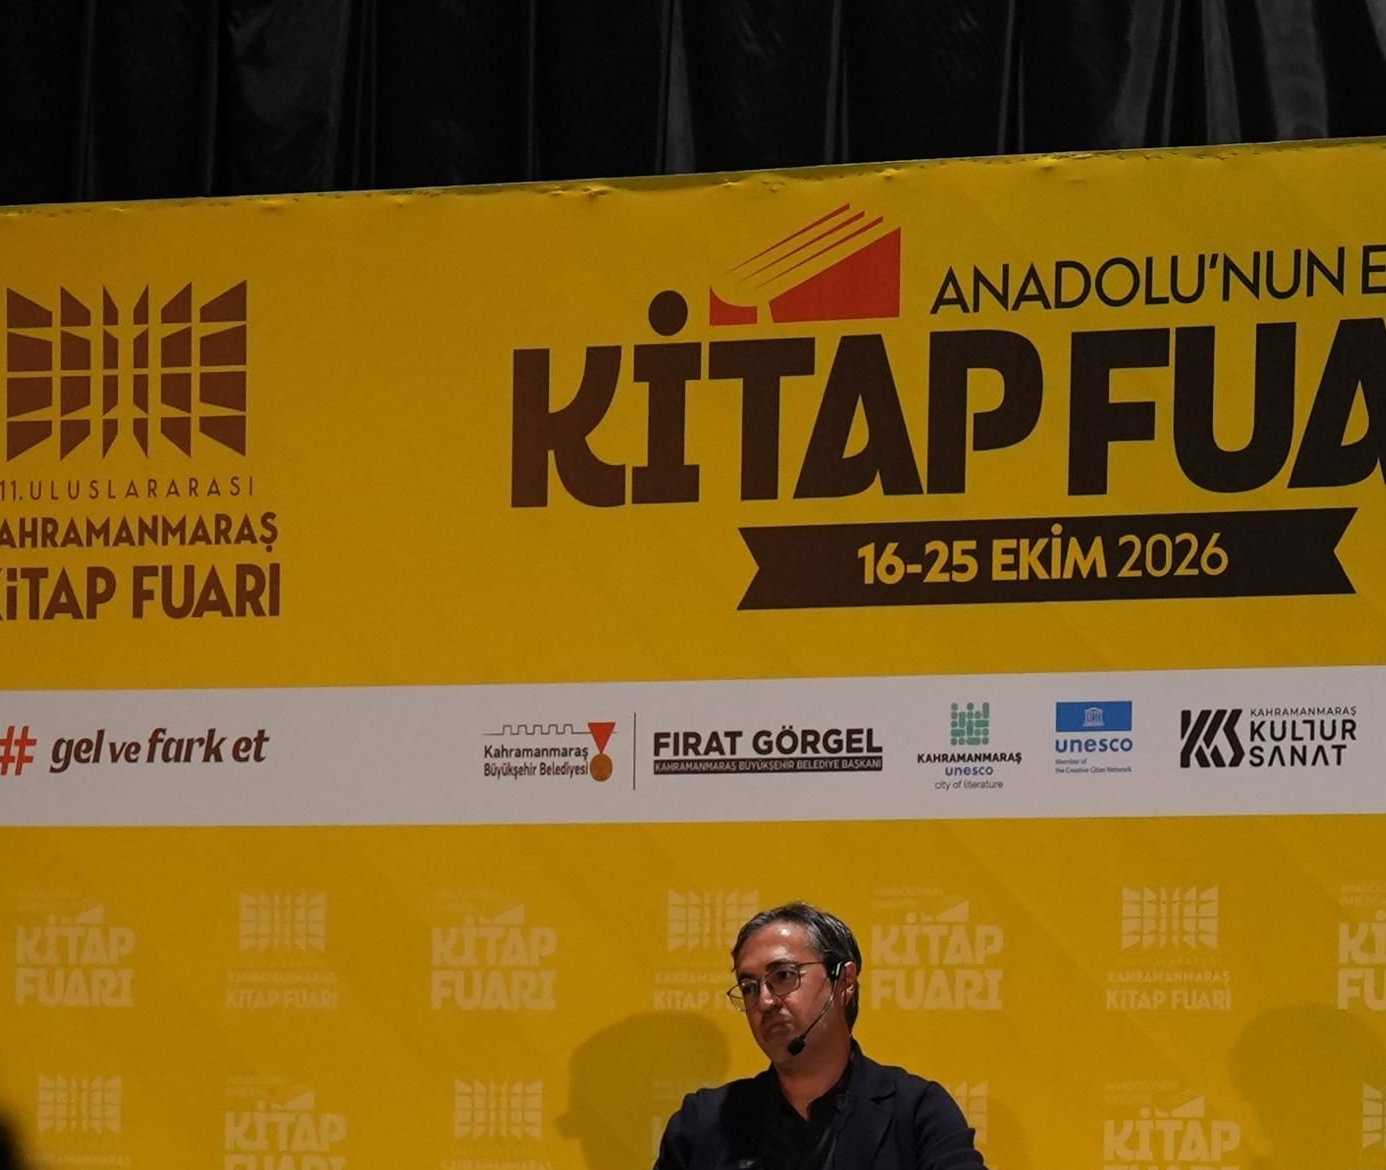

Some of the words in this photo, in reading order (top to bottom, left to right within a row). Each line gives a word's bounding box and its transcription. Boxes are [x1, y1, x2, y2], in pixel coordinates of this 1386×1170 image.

[510, 290, 1044, 508] KİTAP
[856, 540, 979, 586] 16-25
[991, 522, 1107, 582] EKİM
[1116, 531, 1230, 580] 2026
[131, 562, 281, 619] FUARI
[1250, 706, 1358, 717] KAHRAMANMARAŞ
[49, 728, 106, 773] gel
[108, 740, 142, 764] ve
[145, 727, 228, 764] fark
[231, 728, 271, 763] et
[483, 744, 590, 761] Kahramanmaraş
[653, 730, 744, 757] FIRAT
[751, 725, 884, 756] GÖRGEL
[1054, 737, 1134, 753] unesco
[916, 752, 1023, 765] KAHRAMANMARAŞ
[1248, 744, 1348, 767] SANAT
[483, 762, 538, 780] Büyükşehir
[944, 764, 995, 777] unesco
[933, 780, 951, 792] city
[953, 780, 963, 789] of
[964, 780, 1005, 790] literature
[431, 969, 557, 1010] FUARI
[870, 968, 1004, 1010] FUARI
